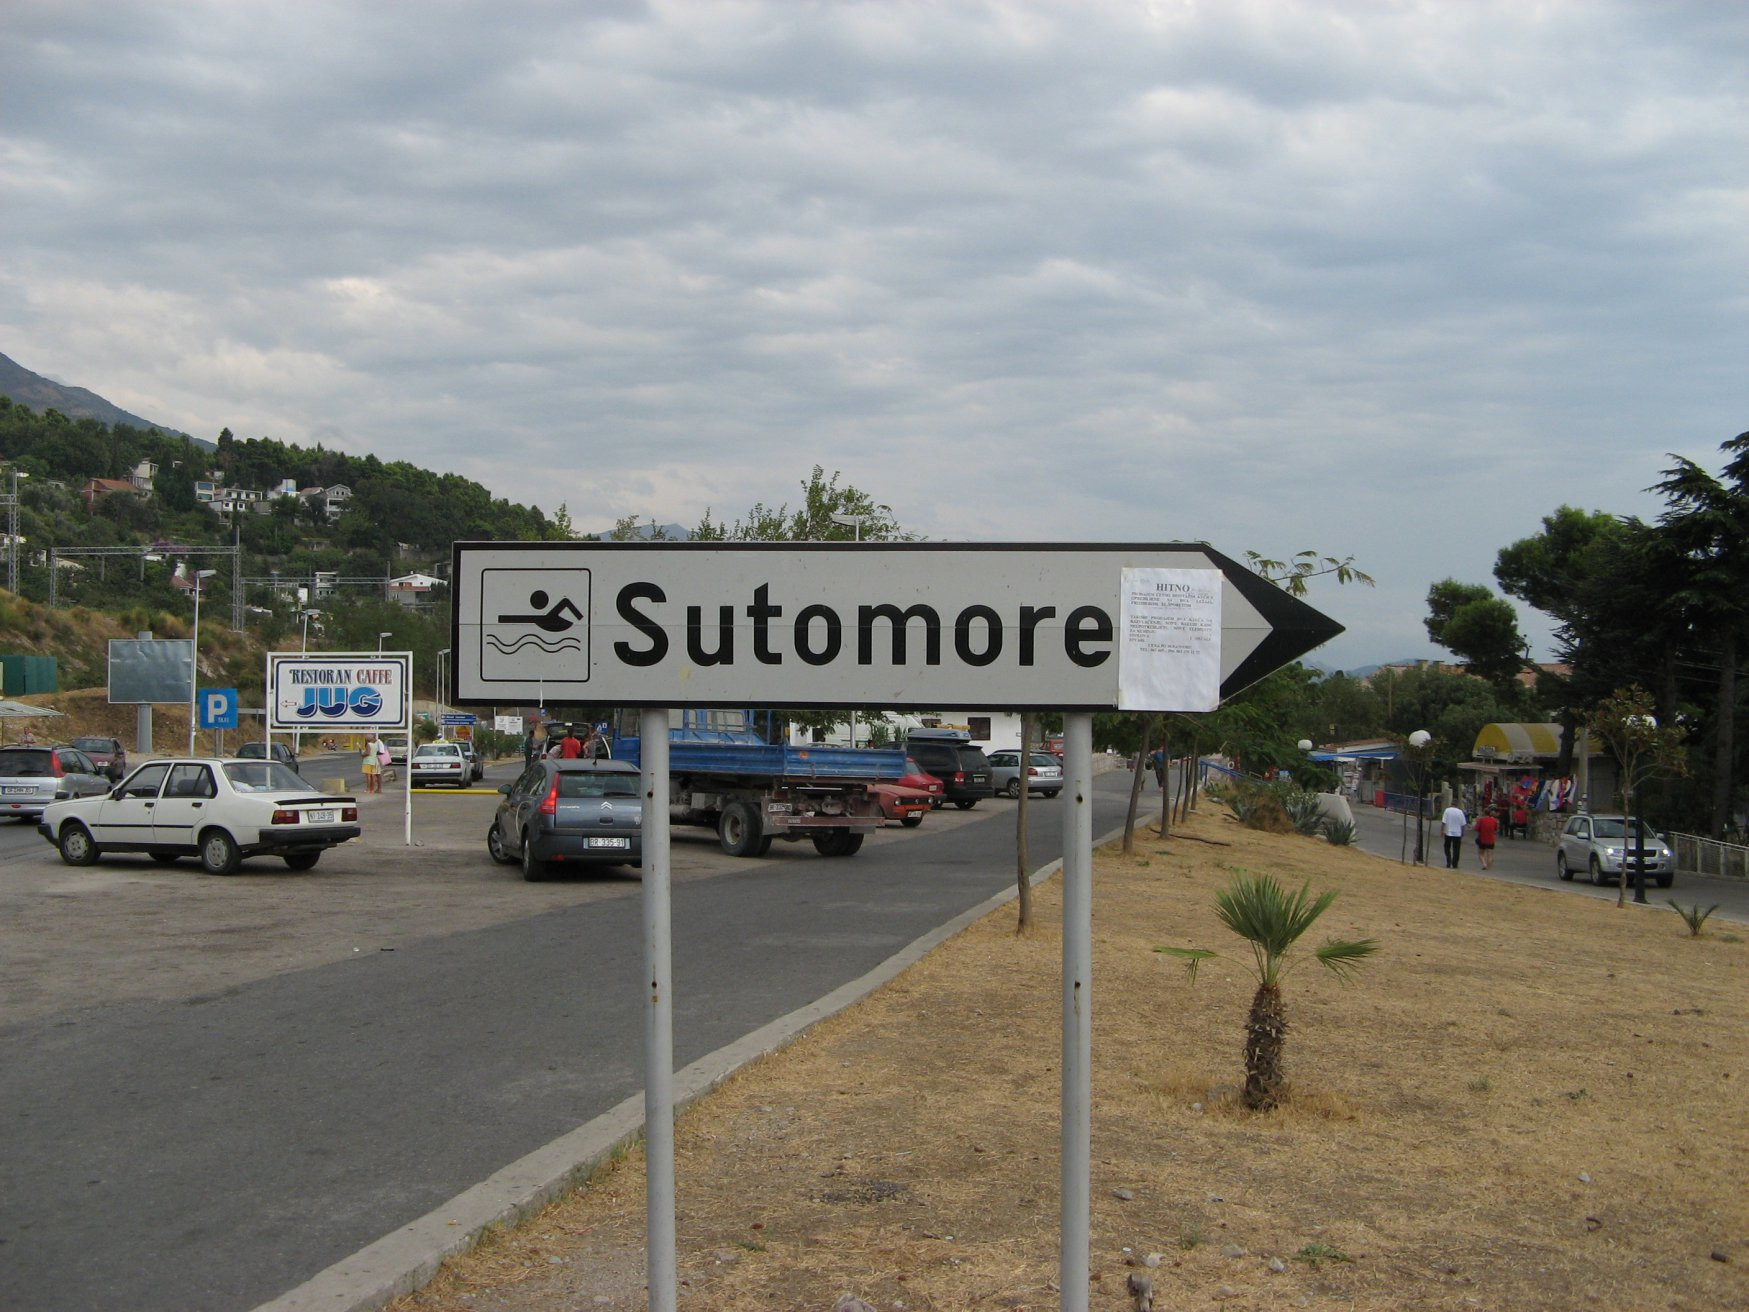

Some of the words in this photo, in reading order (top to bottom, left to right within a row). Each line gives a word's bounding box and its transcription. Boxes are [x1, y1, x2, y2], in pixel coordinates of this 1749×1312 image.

[1156, 583, 1190, 592] HITNO
[613, 582, 1113, 667] Sutomore
[289, 669, 352, 684] RESTORAN
[357, 669, 392, 684] CAFFE
[208, 694, 227, 723] P
[297, 686, 382, 717] JUG
